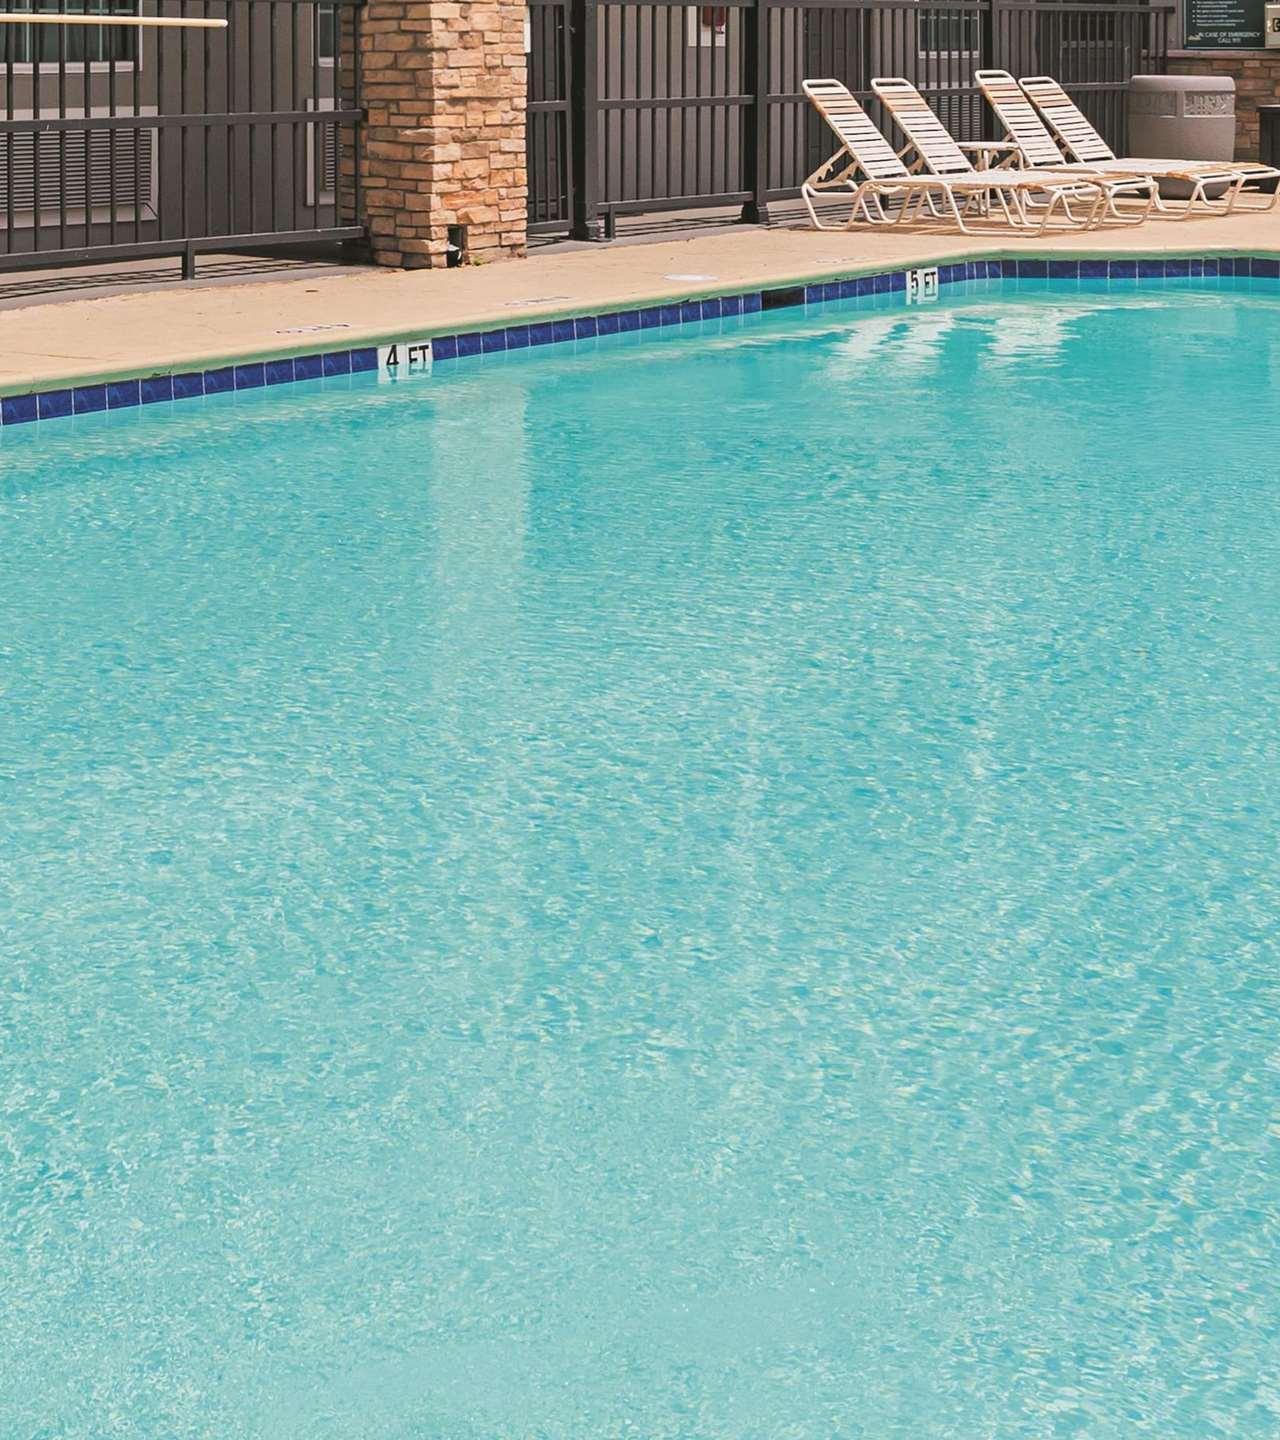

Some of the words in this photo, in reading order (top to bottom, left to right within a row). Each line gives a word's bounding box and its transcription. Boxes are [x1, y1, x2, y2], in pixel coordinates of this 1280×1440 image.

[910, 270, 919, 289] 5
[386, 344, 399, 366] 4
[408, 344, 429, 364] FT
